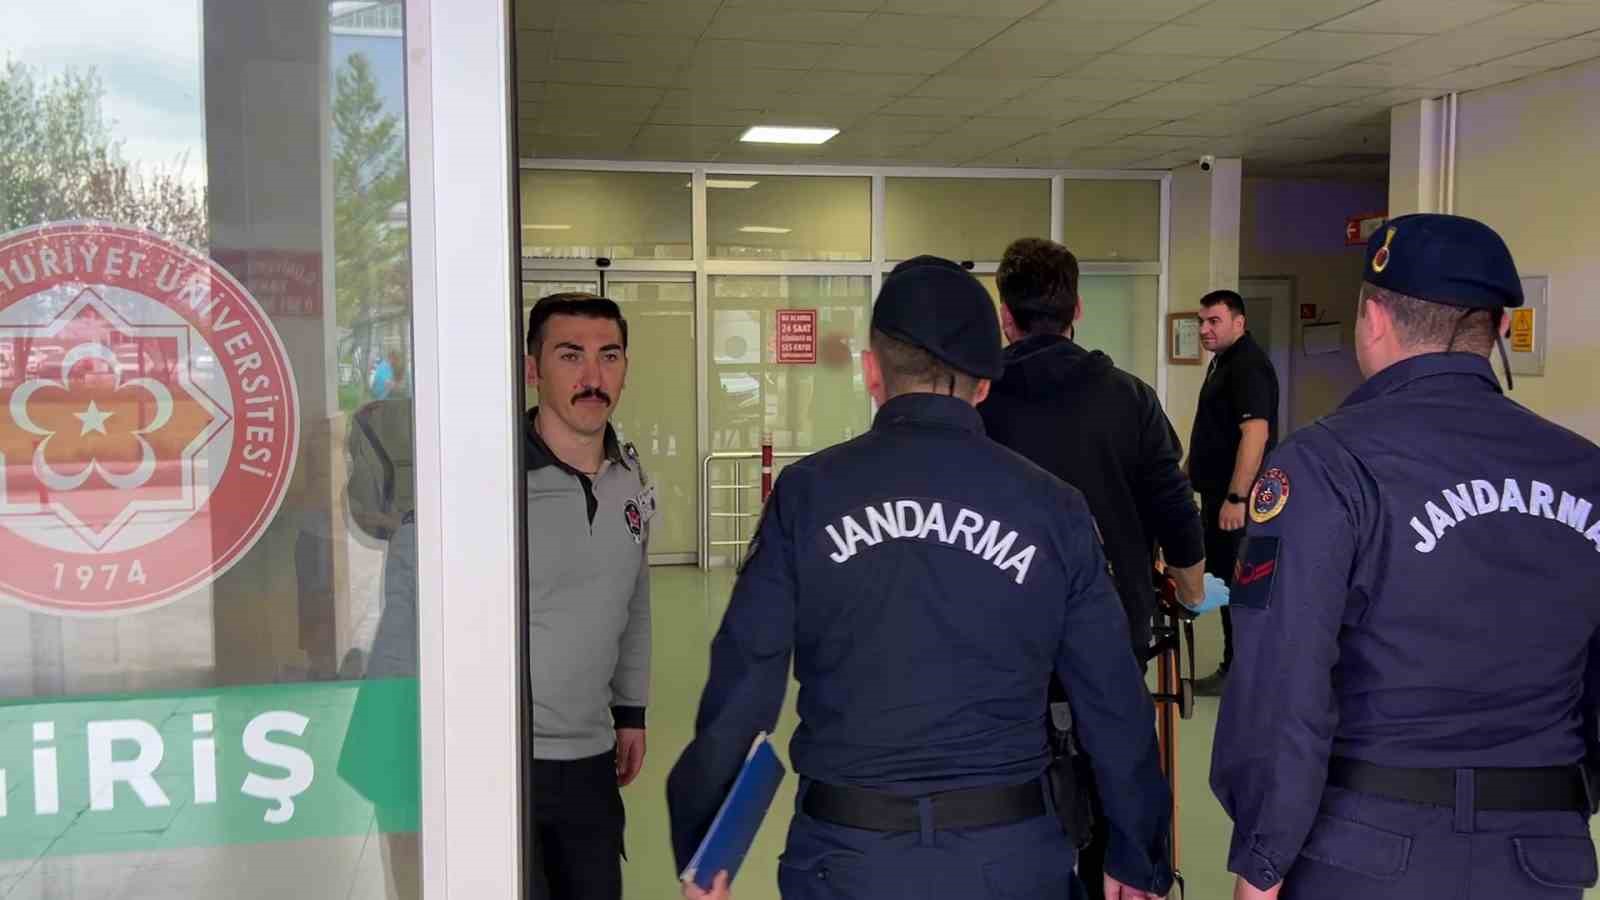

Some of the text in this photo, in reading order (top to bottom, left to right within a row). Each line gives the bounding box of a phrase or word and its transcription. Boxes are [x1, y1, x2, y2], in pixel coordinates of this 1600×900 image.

[155, 254, 279, 479] ÜNİVERSİTESİ
[52, 559, 147, 591] 1974
[823, 499, 1038, 585] JANDARMA
[0, 710, 315, 825] İRİŞ
